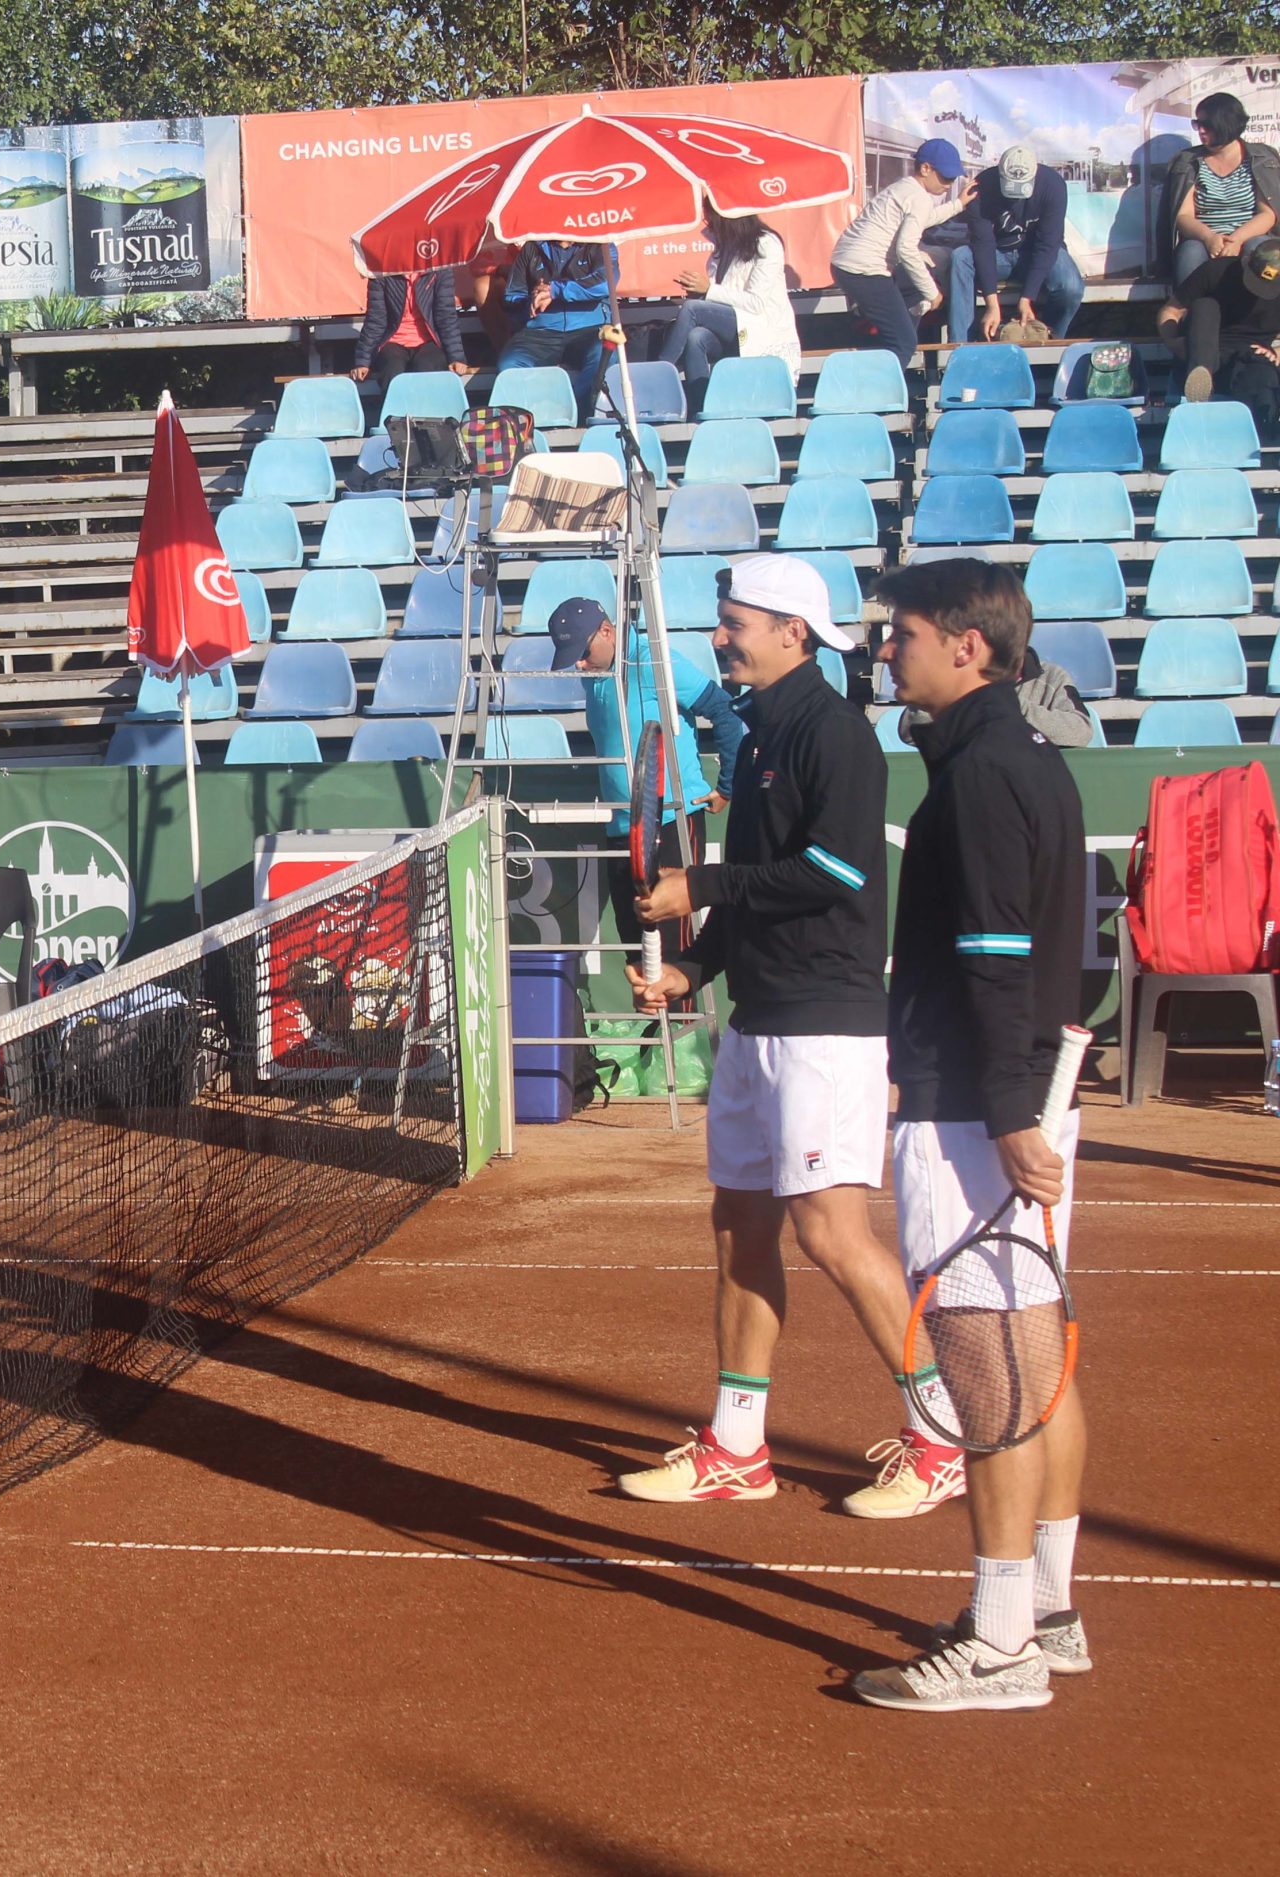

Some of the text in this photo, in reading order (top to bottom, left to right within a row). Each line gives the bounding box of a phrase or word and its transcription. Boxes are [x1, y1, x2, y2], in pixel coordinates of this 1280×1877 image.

[279, 132, 472, 161] CHANGING LIVES
[563, 208, 634, 228] ALGIDA
[91, 223, 195, 269] Tușnad
[643, 246, 658, 256] at
[663, 243, 687, 254] the
[465, 867, 480, 1084] ATP
[477, 840, 489, 1147] CHALLENGER
